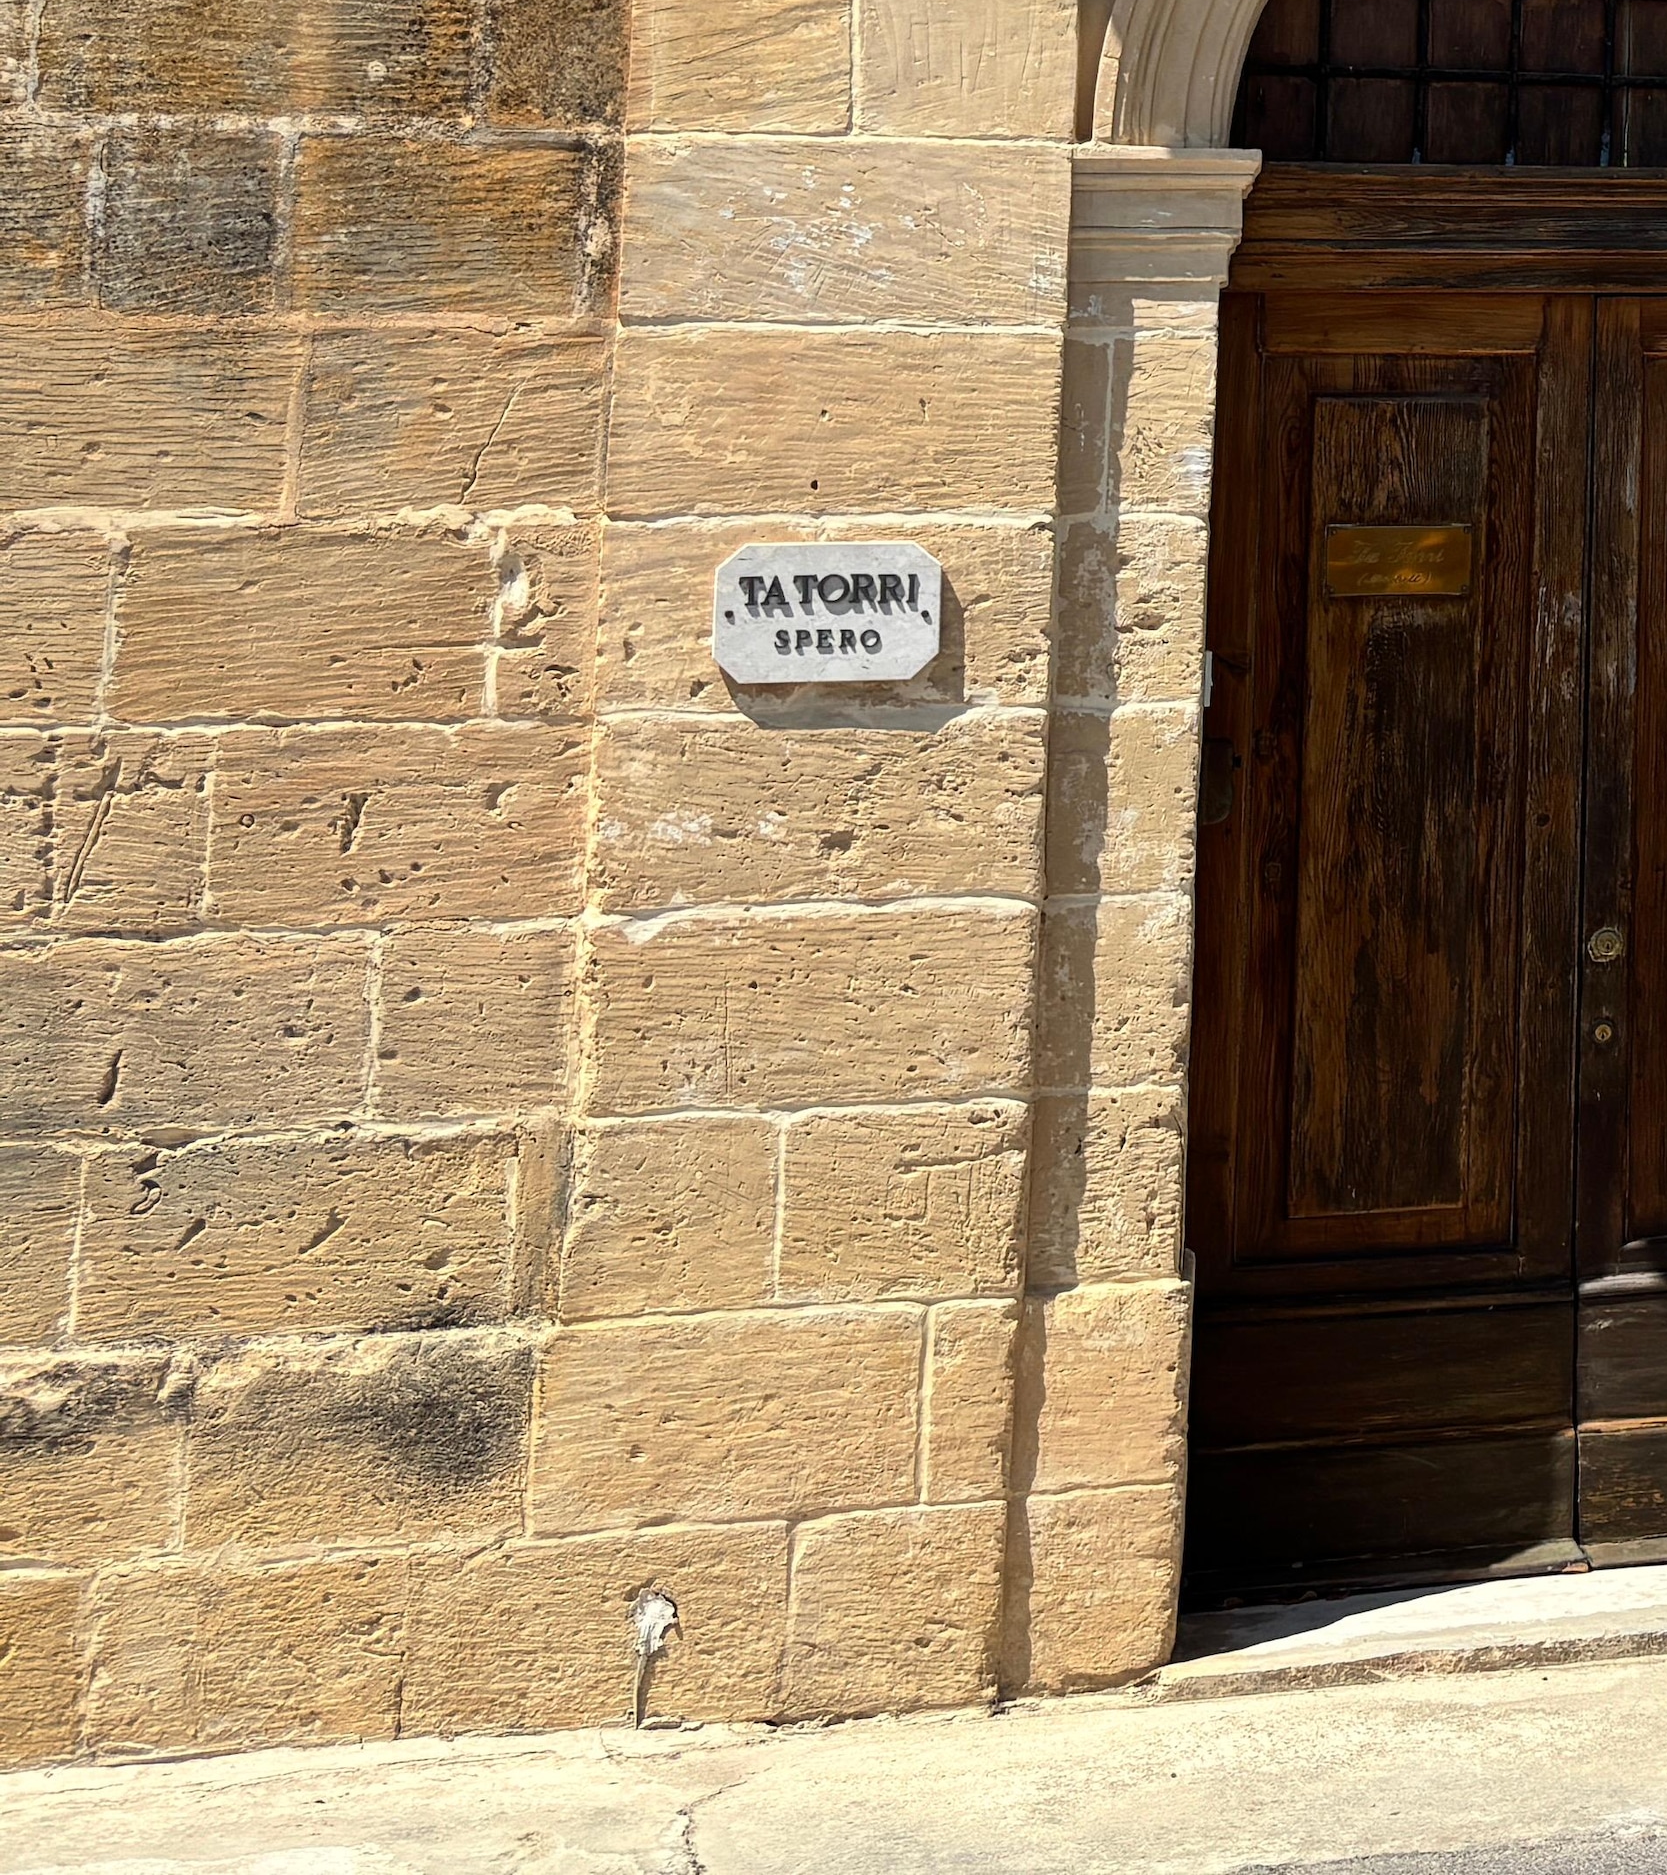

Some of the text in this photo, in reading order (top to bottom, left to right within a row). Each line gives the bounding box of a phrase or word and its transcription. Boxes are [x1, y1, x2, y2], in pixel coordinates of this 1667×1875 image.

[739, 573, 920, 611] TA TORRI
[774, 628, 882, 653] SPERO
